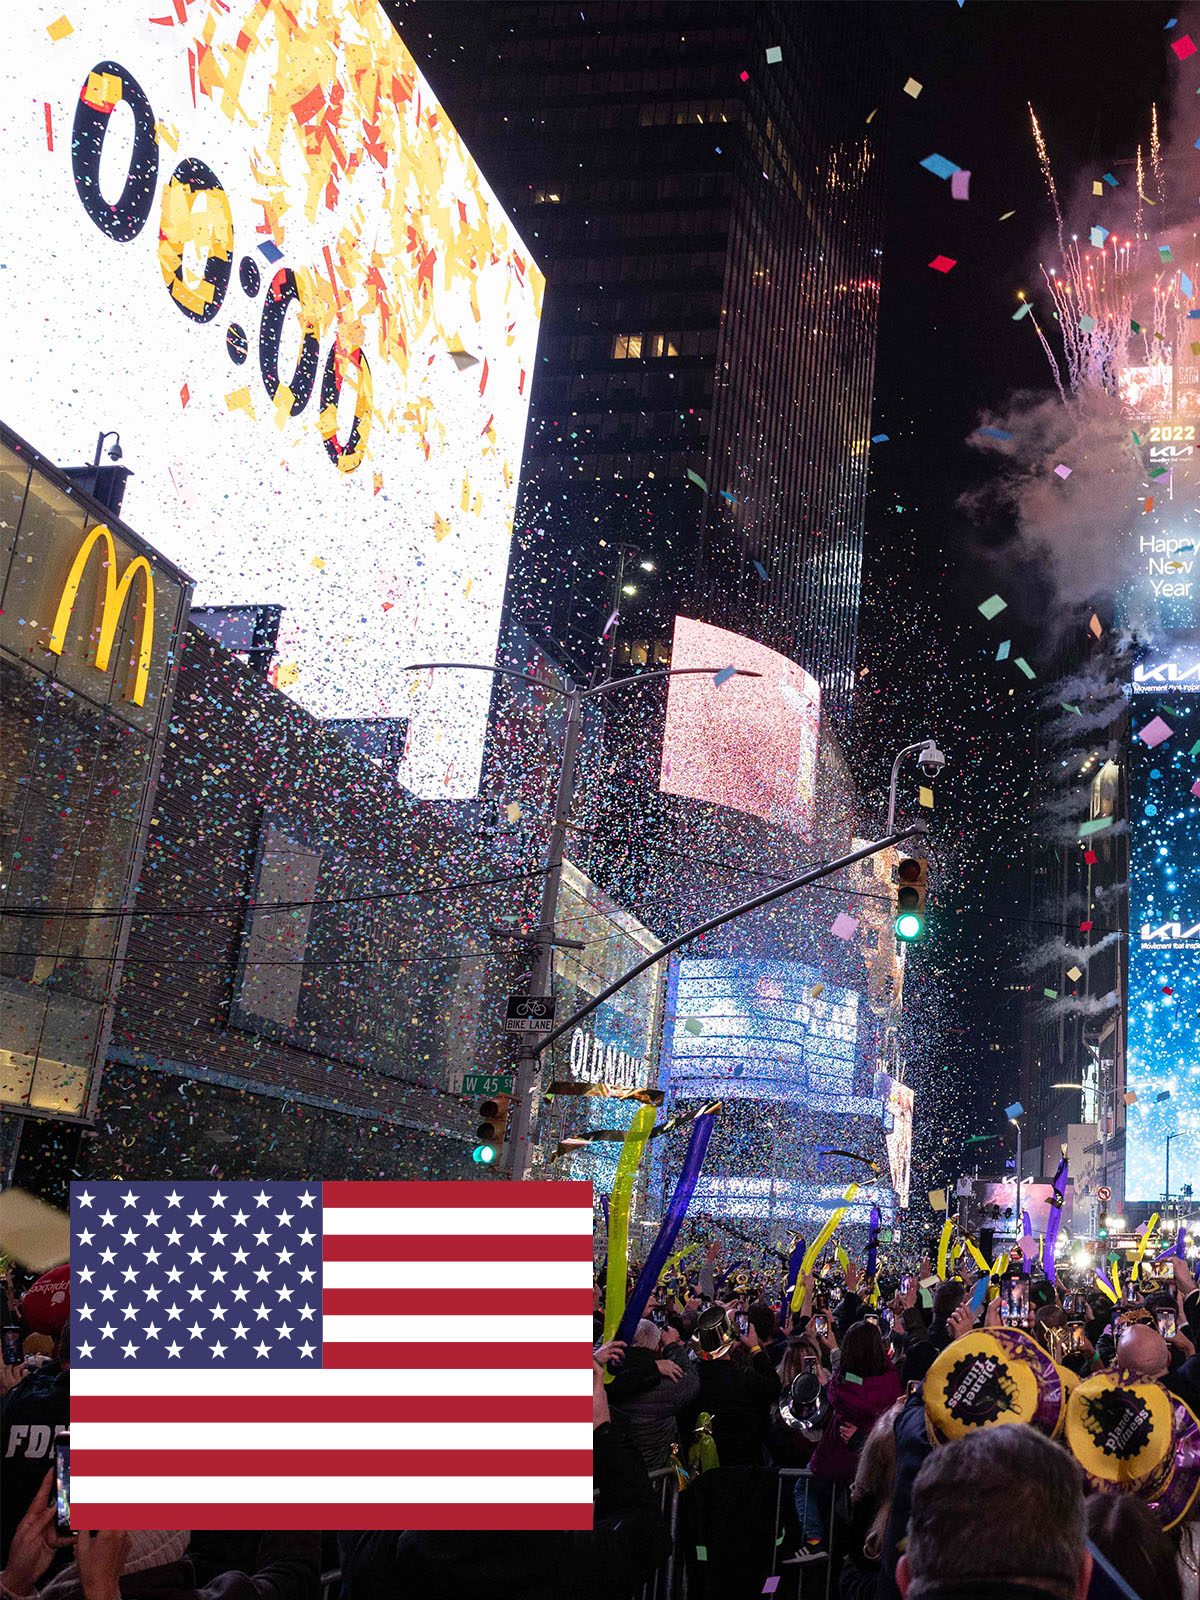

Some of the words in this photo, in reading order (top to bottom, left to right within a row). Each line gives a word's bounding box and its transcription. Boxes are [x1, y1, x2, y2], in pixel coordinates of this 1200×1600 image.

[1149, 425, 1196, 442] 2022
[1149, 445, 1194, 457] KIA
[1149, 557, 1194, 575] New
[1150, 579, 1194, 597] Year
[507, 1019, 525, 1029] BIKE
[529, 1019, 551, 1030] LANE
[571, 1027, 603, 1084] OLD
[466, 1077, 478, 1091] W
[483, 1078, 499, 1092] 45
[1002, 1176, 1034, 1185] KA
[948, 1359, 986, 1408] fitness
[962, 1359, 997, 1406] planet
[1105, 1408, 1135, 1451] planet
[1116, 1409, 1150, 1450] fitness
